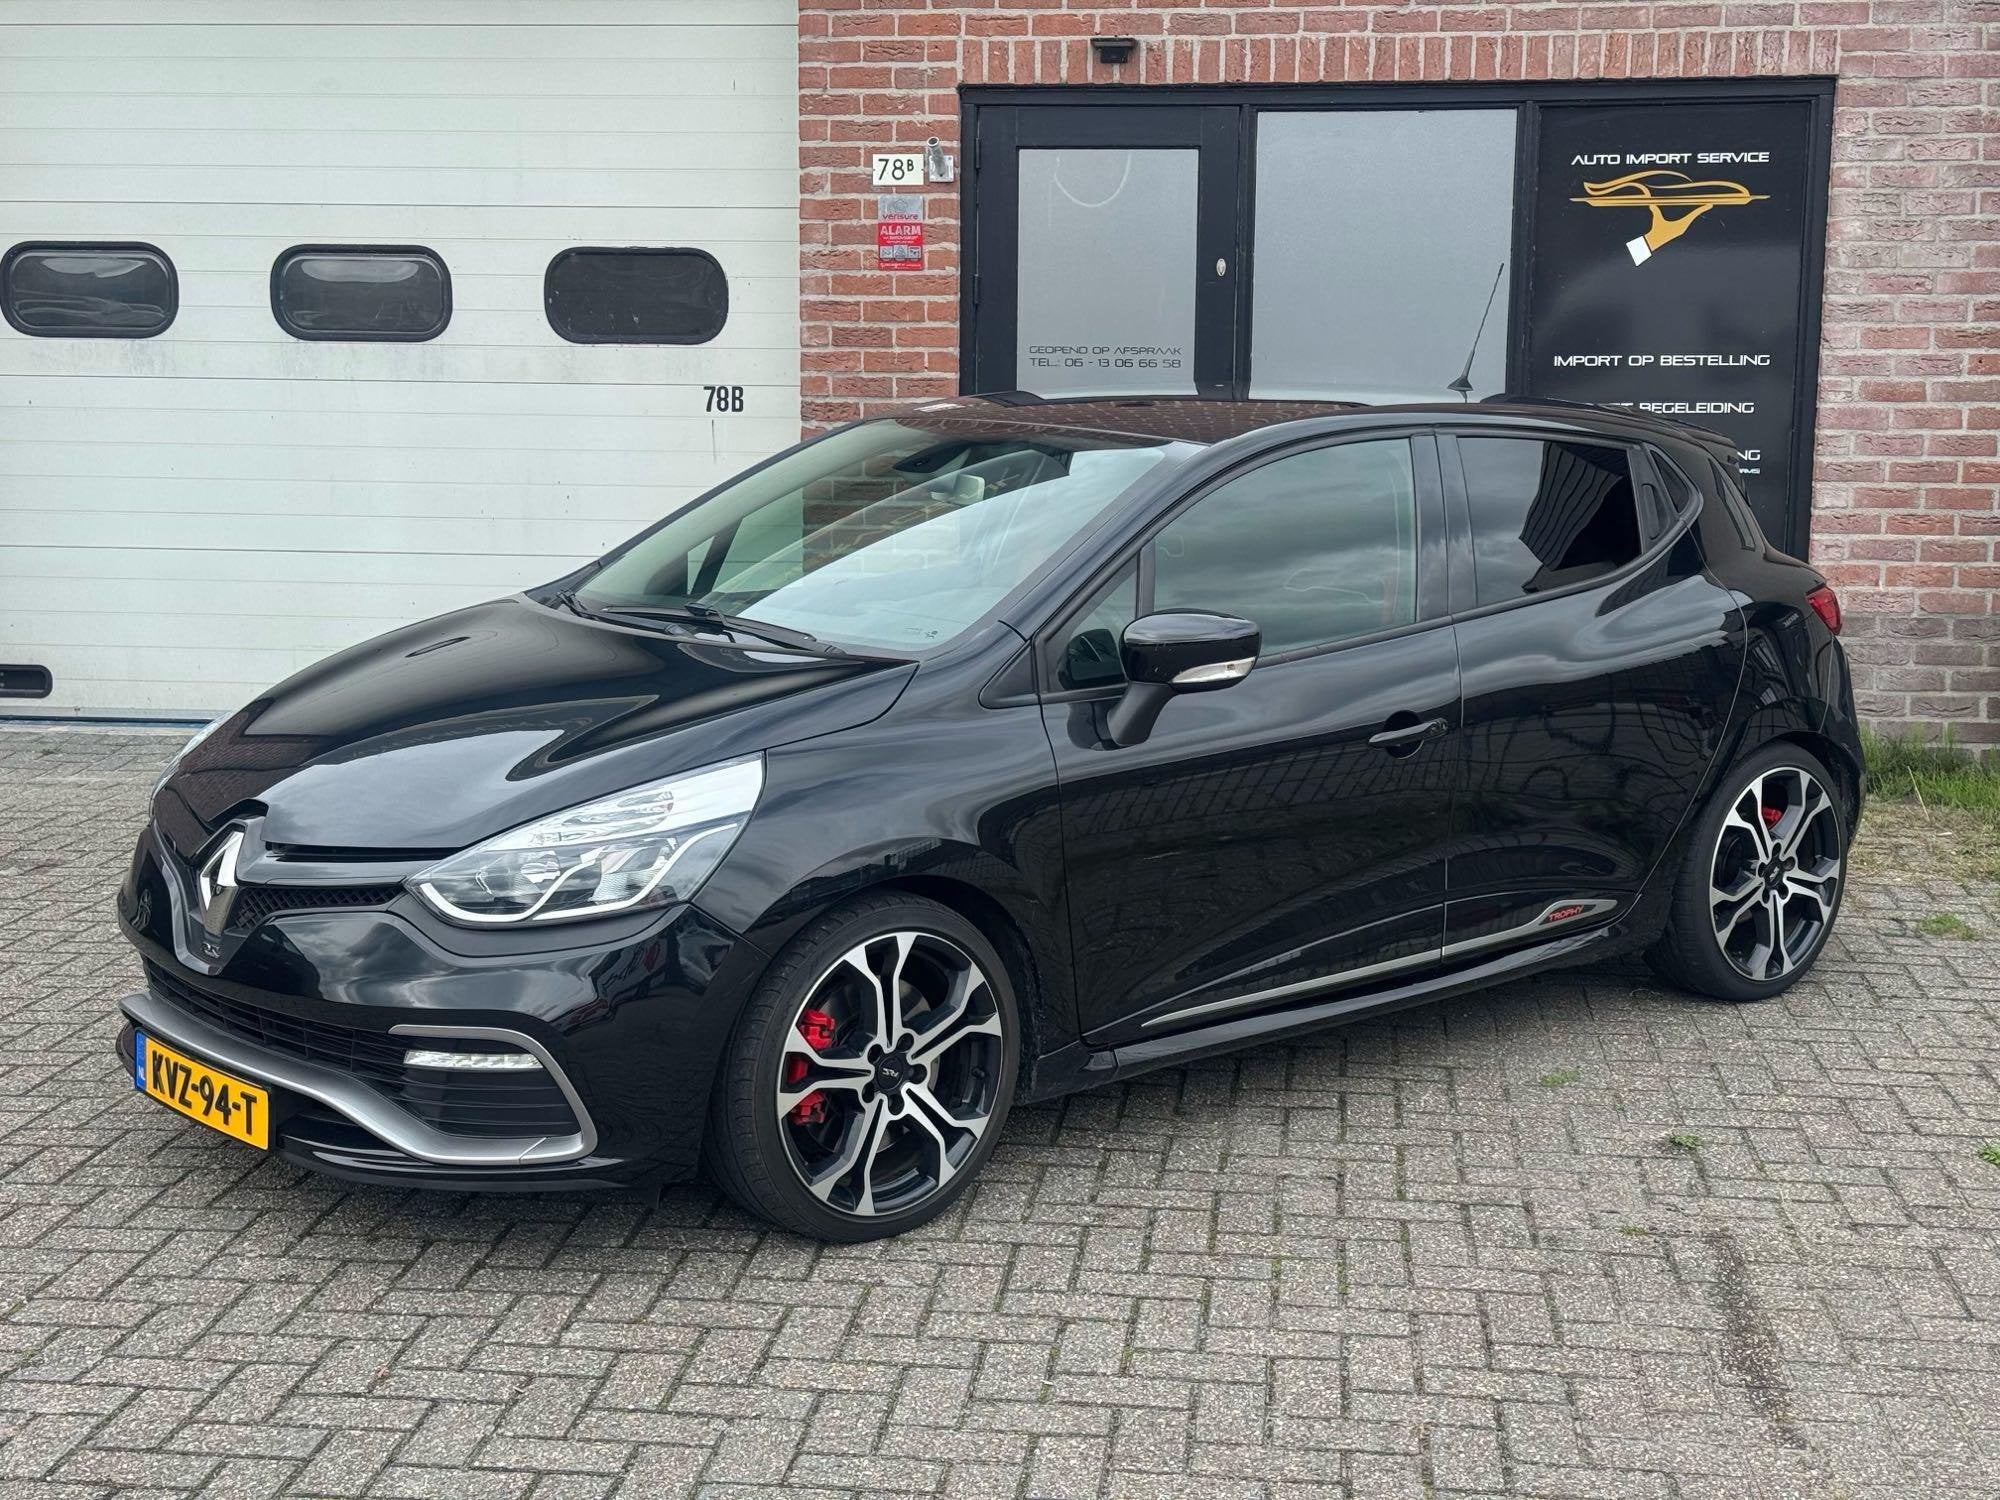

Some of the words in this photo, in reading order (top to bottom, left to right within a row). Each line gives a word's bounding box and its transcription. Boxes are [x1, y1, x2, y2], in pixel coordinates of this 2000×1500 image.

[1571, 154, 1621, 165] AUTO
[1626, 153, 1692, 164] IMPORT
[1697, 152, 1770, 163] SERVICE
[880, 225, 921, 236] ALARM
[1092, 346, 1110, 355] OP
[1114, 346, 1182, 355] AFSPRAAK
[1064, 357, 1084, 367] 06
[1098, 358, 1110, 368] 13
[1114, 358, 1134, 368] 06
[1138, 358, 1158, 368] 66
[1162, 358, 1182, 368] 58
[1553, 355, 1623, 367] IMPORT
[1628, 355, 1655, 367] OP
[1660, 354, 1771, 367] BESTELLING
[703, 385, 744, 413] 78B
[1549, 905, 1584, 920] TROPHY
[151, 1049, 257, 1136] KVZ-94-T
